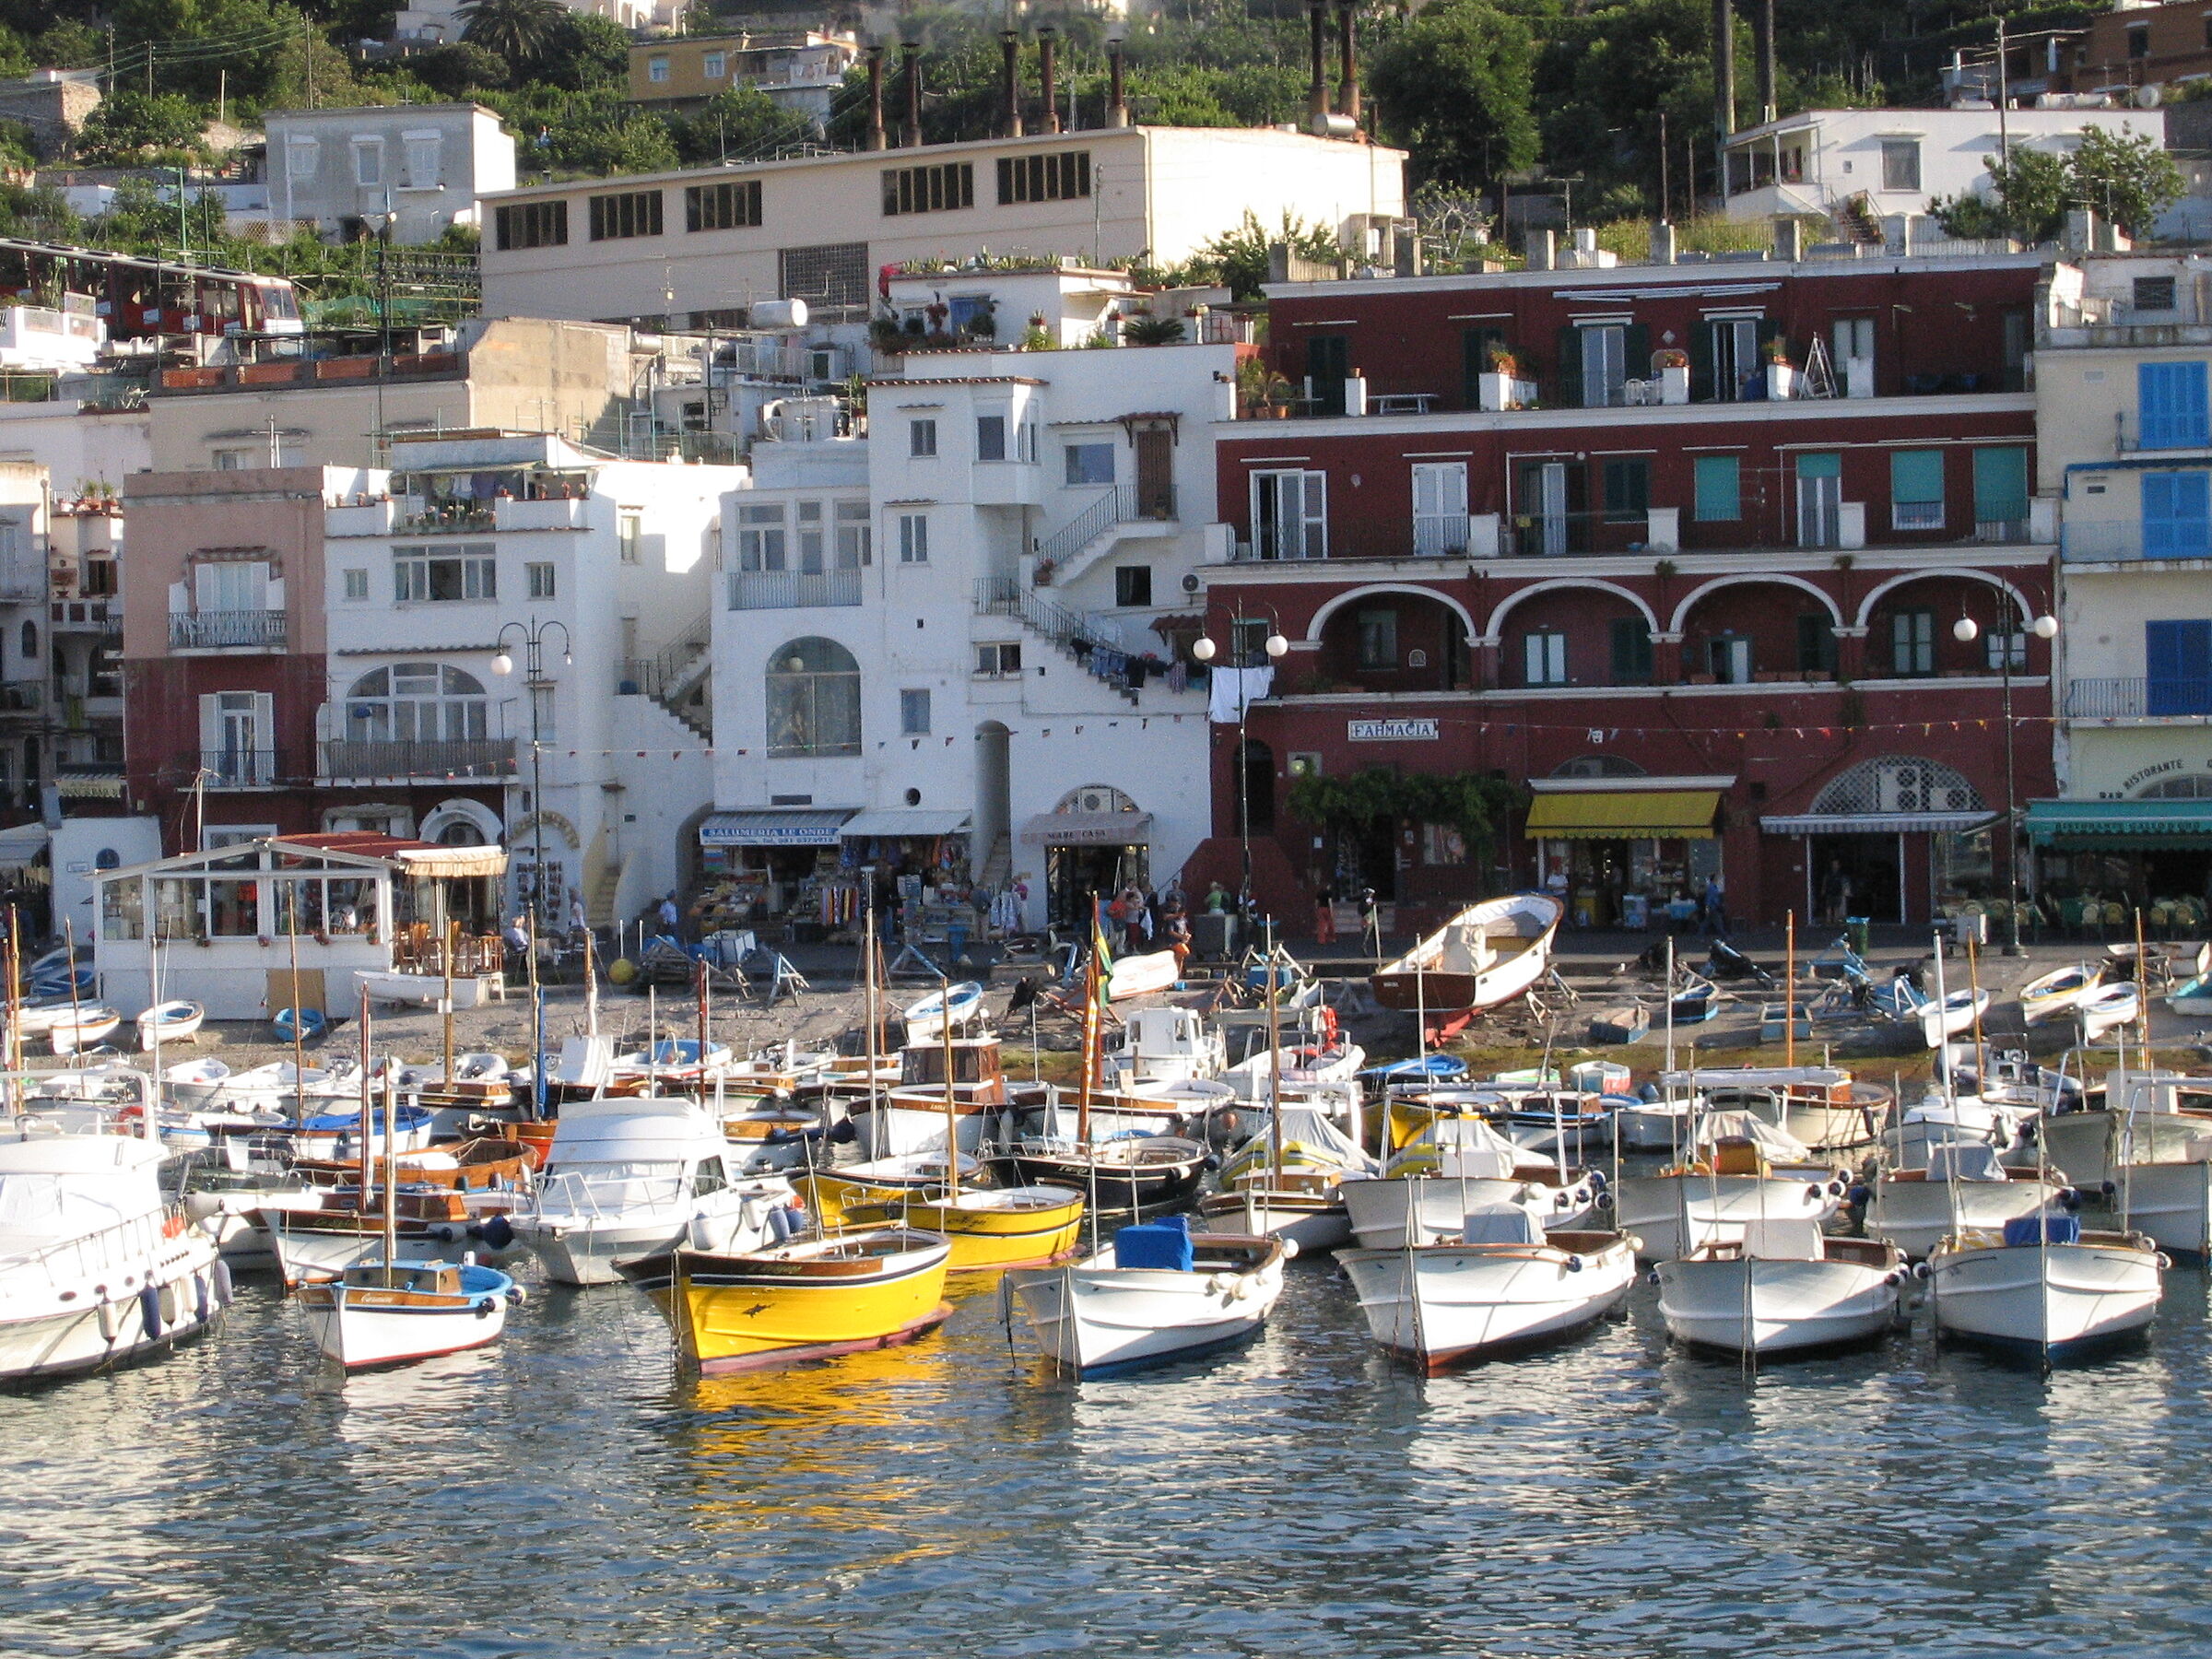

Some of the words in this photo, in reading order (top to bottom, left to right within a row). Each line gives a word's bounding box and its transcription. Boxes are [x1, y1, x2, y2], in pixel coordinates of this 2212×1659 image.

[1354, 723, 1430, 736] FARMACIA
[2123, 759, 2184, 790] RISTORANTE
[2054, 821, 2124, 830] RISTORANTE
[708, 829, 780, 837] SALUMERIA
[782, 829, 795, 837] LE
[798, 829, 833, 837] ONDE
